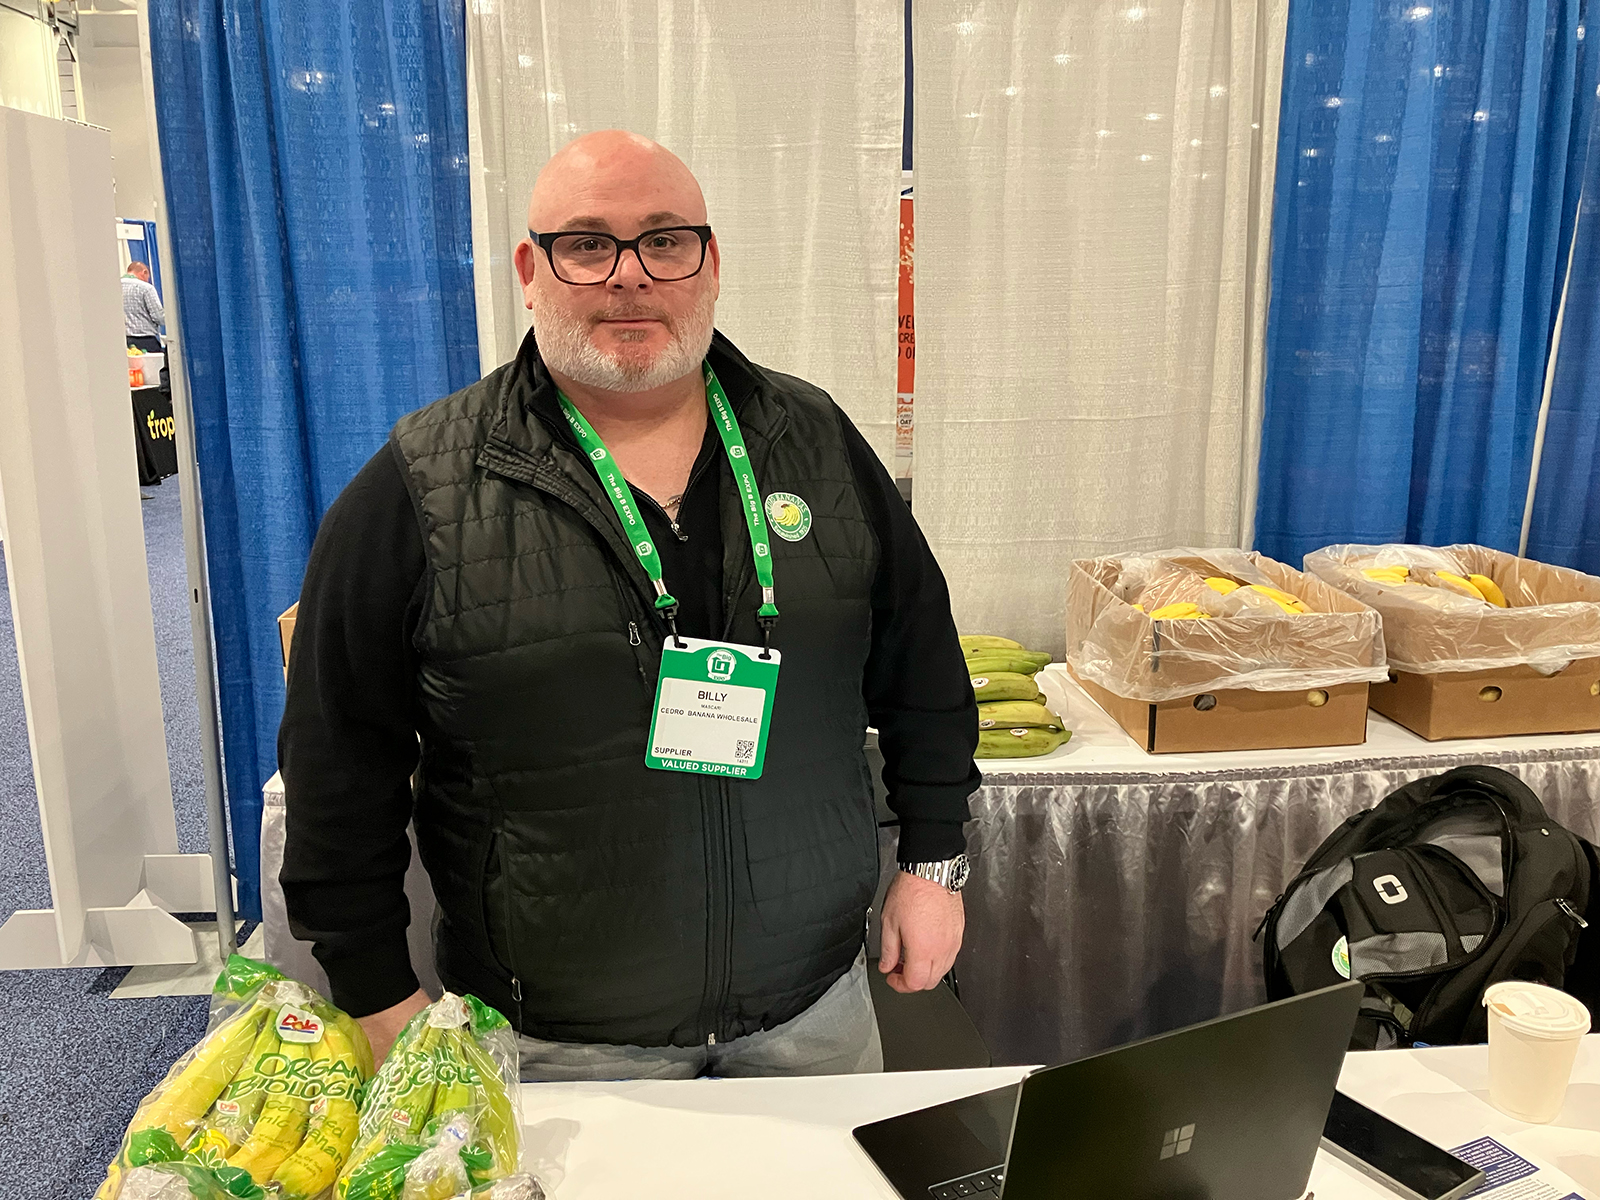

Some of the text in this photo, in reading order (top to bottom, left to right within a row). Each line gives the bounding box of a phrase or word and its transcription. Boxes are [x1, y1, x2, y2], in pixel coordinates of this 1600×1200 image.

[147, 415, 175, 440] trop
[573, 421, 587, 438] EXPO
[742, 473, 752, 493] EXPO
[607, 473, 616, 487] The
[613, 486, 623, 499] Big
[622, 505, 636, 525] EXPO
[749, 500, 757, 512] Big
[697, 690, 728, 702] BILLY
[687, 710, 716, 719] BANANA
[716, 713, 758, 724] WHOLESALE
[654, 747, 692, 757] SUPPLIER
[661, 759, 747, 776] VALUED SUPPLIER
[282, 1013, 318, 1031] Dole
